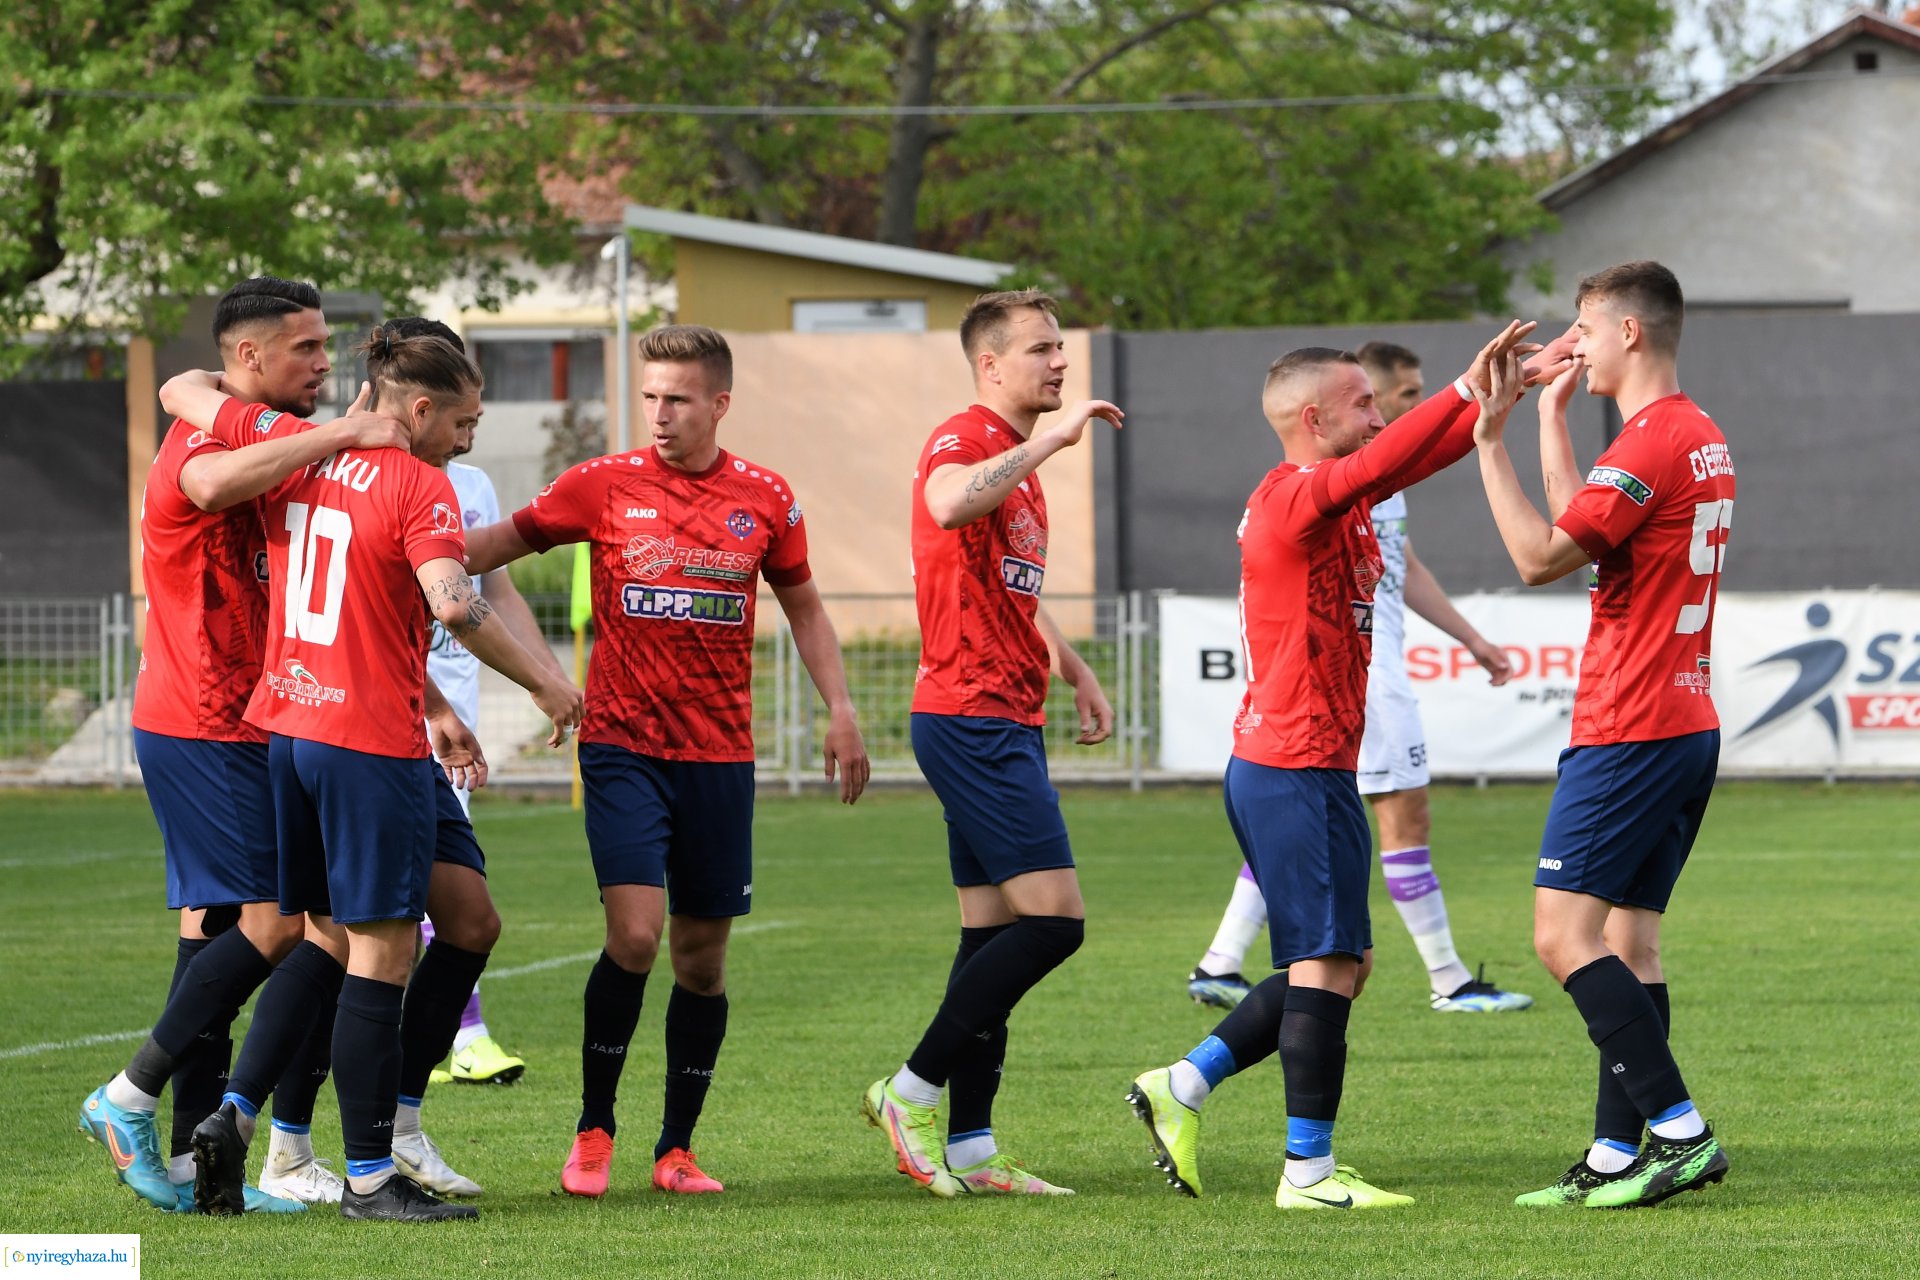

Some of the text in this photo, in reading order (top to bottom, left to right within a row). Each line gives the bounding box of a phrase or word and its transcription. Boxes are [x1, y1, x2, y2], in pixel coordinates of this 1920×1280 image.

[625, 507, 658, 519] JAKO
[284, 501, 353, 647] 10
[1406, 646, 1590, 680] SPOR
[1538, 857, 1563, 871] JAKO
[590, 1042, 625, 1055] JAKO
[681, 1066, 714, 1077] JAKO
